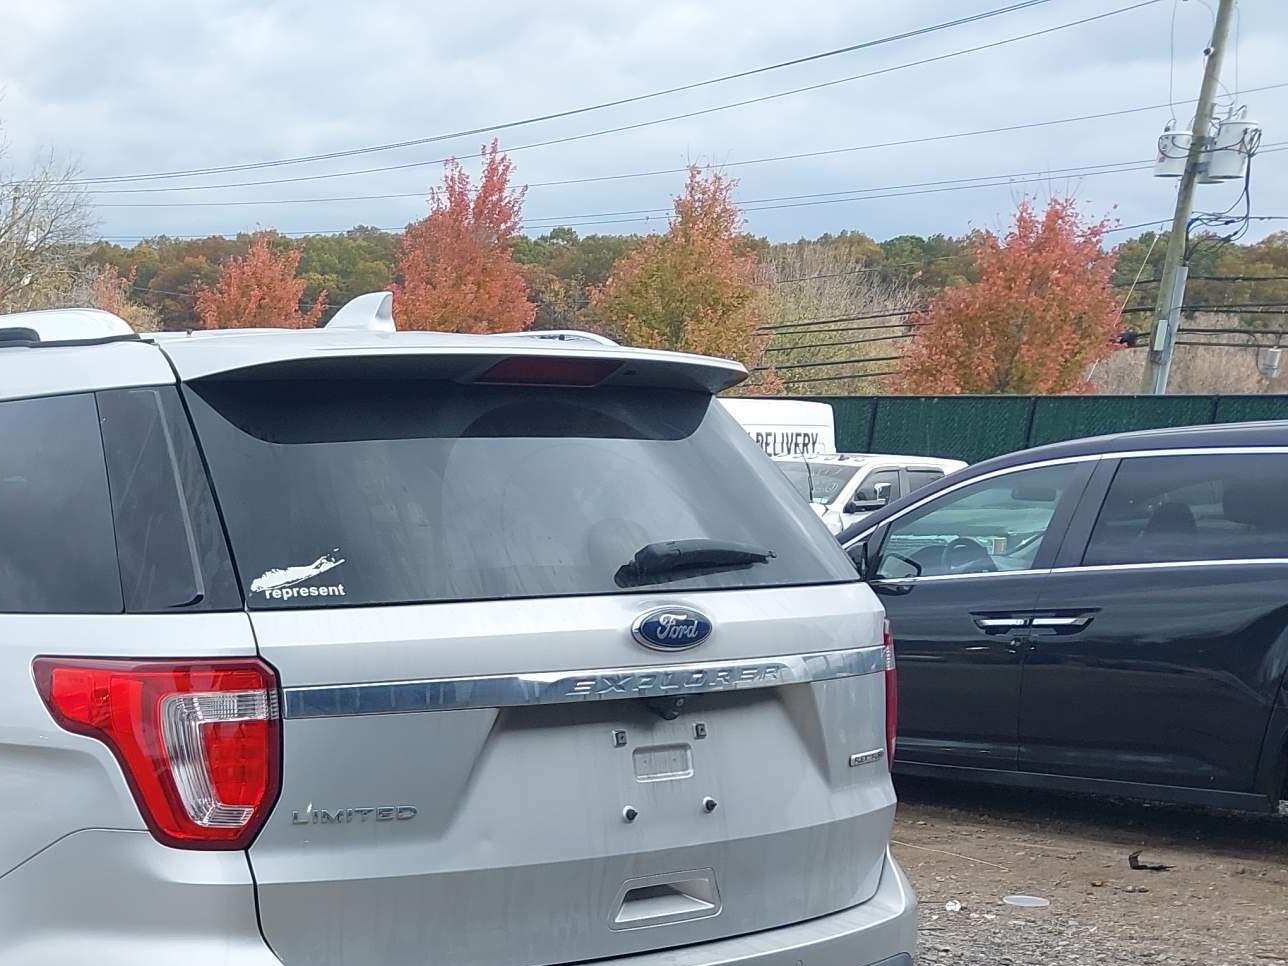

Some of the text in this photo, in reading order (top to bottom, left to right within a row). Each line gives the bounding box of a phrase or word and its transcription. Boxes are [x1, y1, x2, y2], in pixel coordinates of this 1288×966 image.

[756, 432, 818, 457] DELIVERY
[265, 584, 345, 600] represent
[656, 613, 699, 639] Ford
[565, 667, 779, 696] EXPLORER
[291, 805, 418, 825] LIMITED
